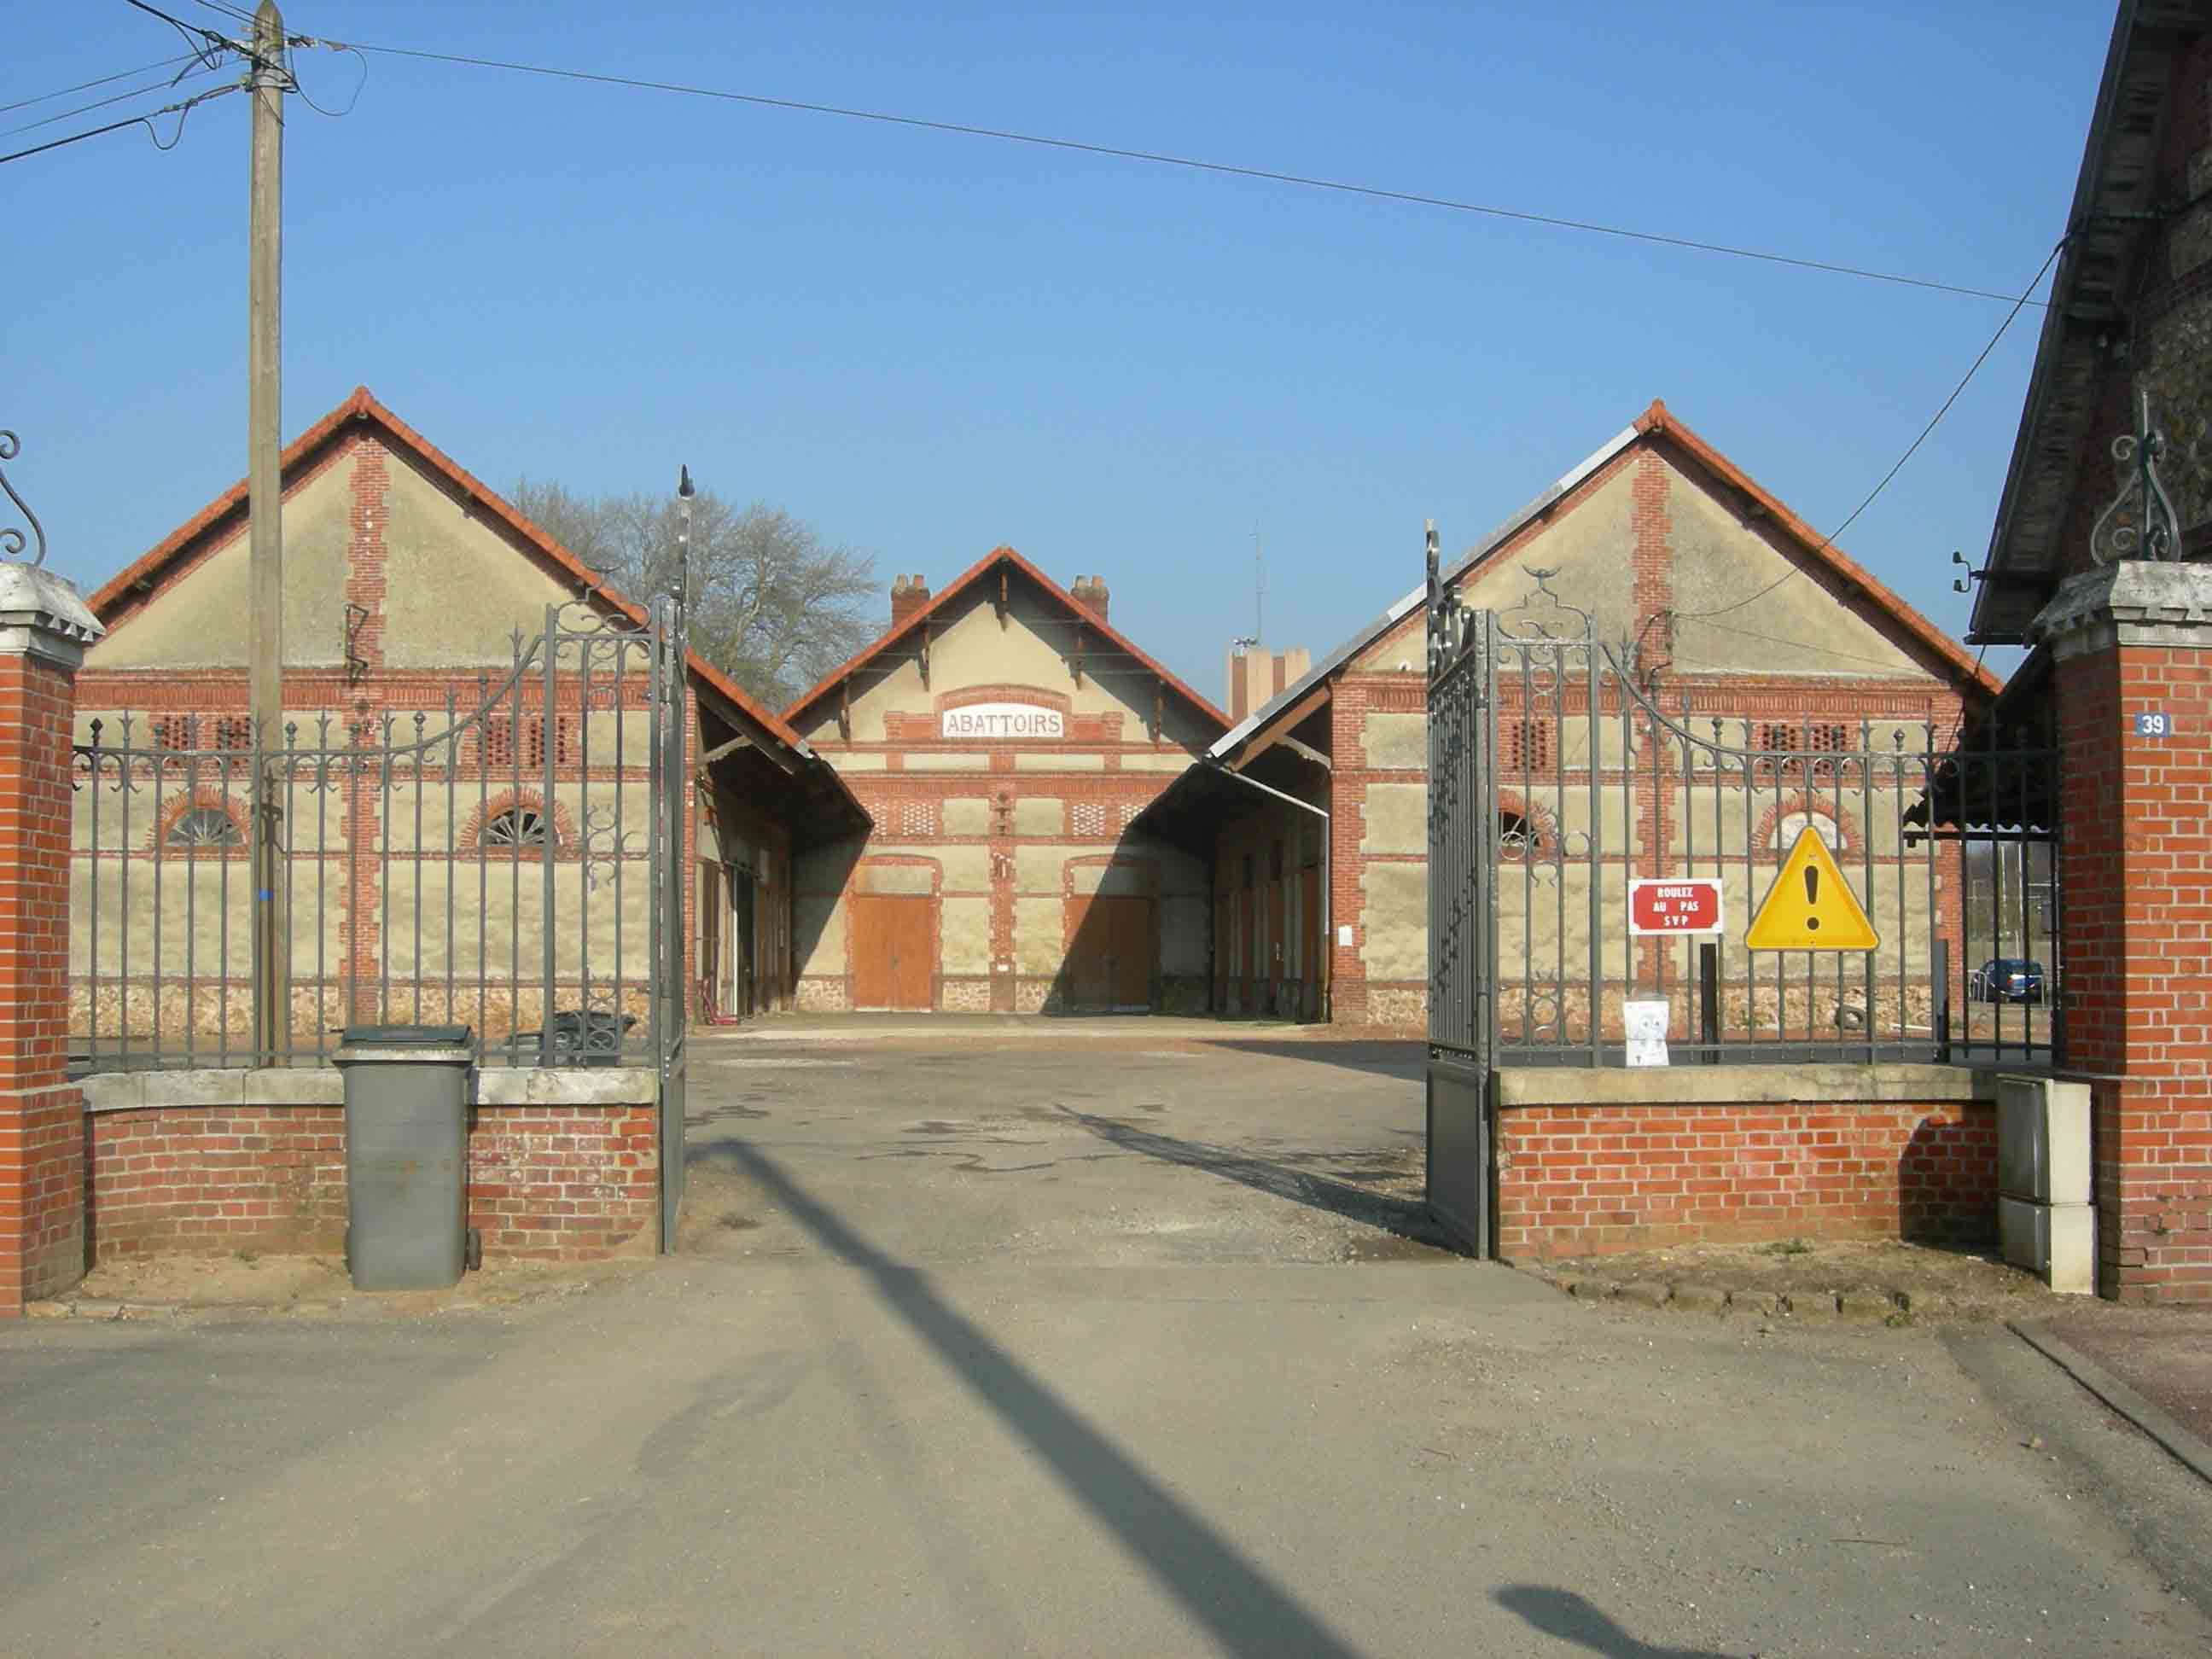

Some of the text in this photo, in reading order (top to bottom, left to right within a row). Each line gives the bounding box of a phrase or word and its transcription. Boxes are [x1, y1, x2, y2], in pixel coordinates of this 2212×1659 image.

[946, 714, 1060, 733] ABATTOIRS
[2142, 715, 2164, 734] 39
[1657, 887, 1693, 898] ROULEZ
[1652, 900, 1699, 912] AU PAS
